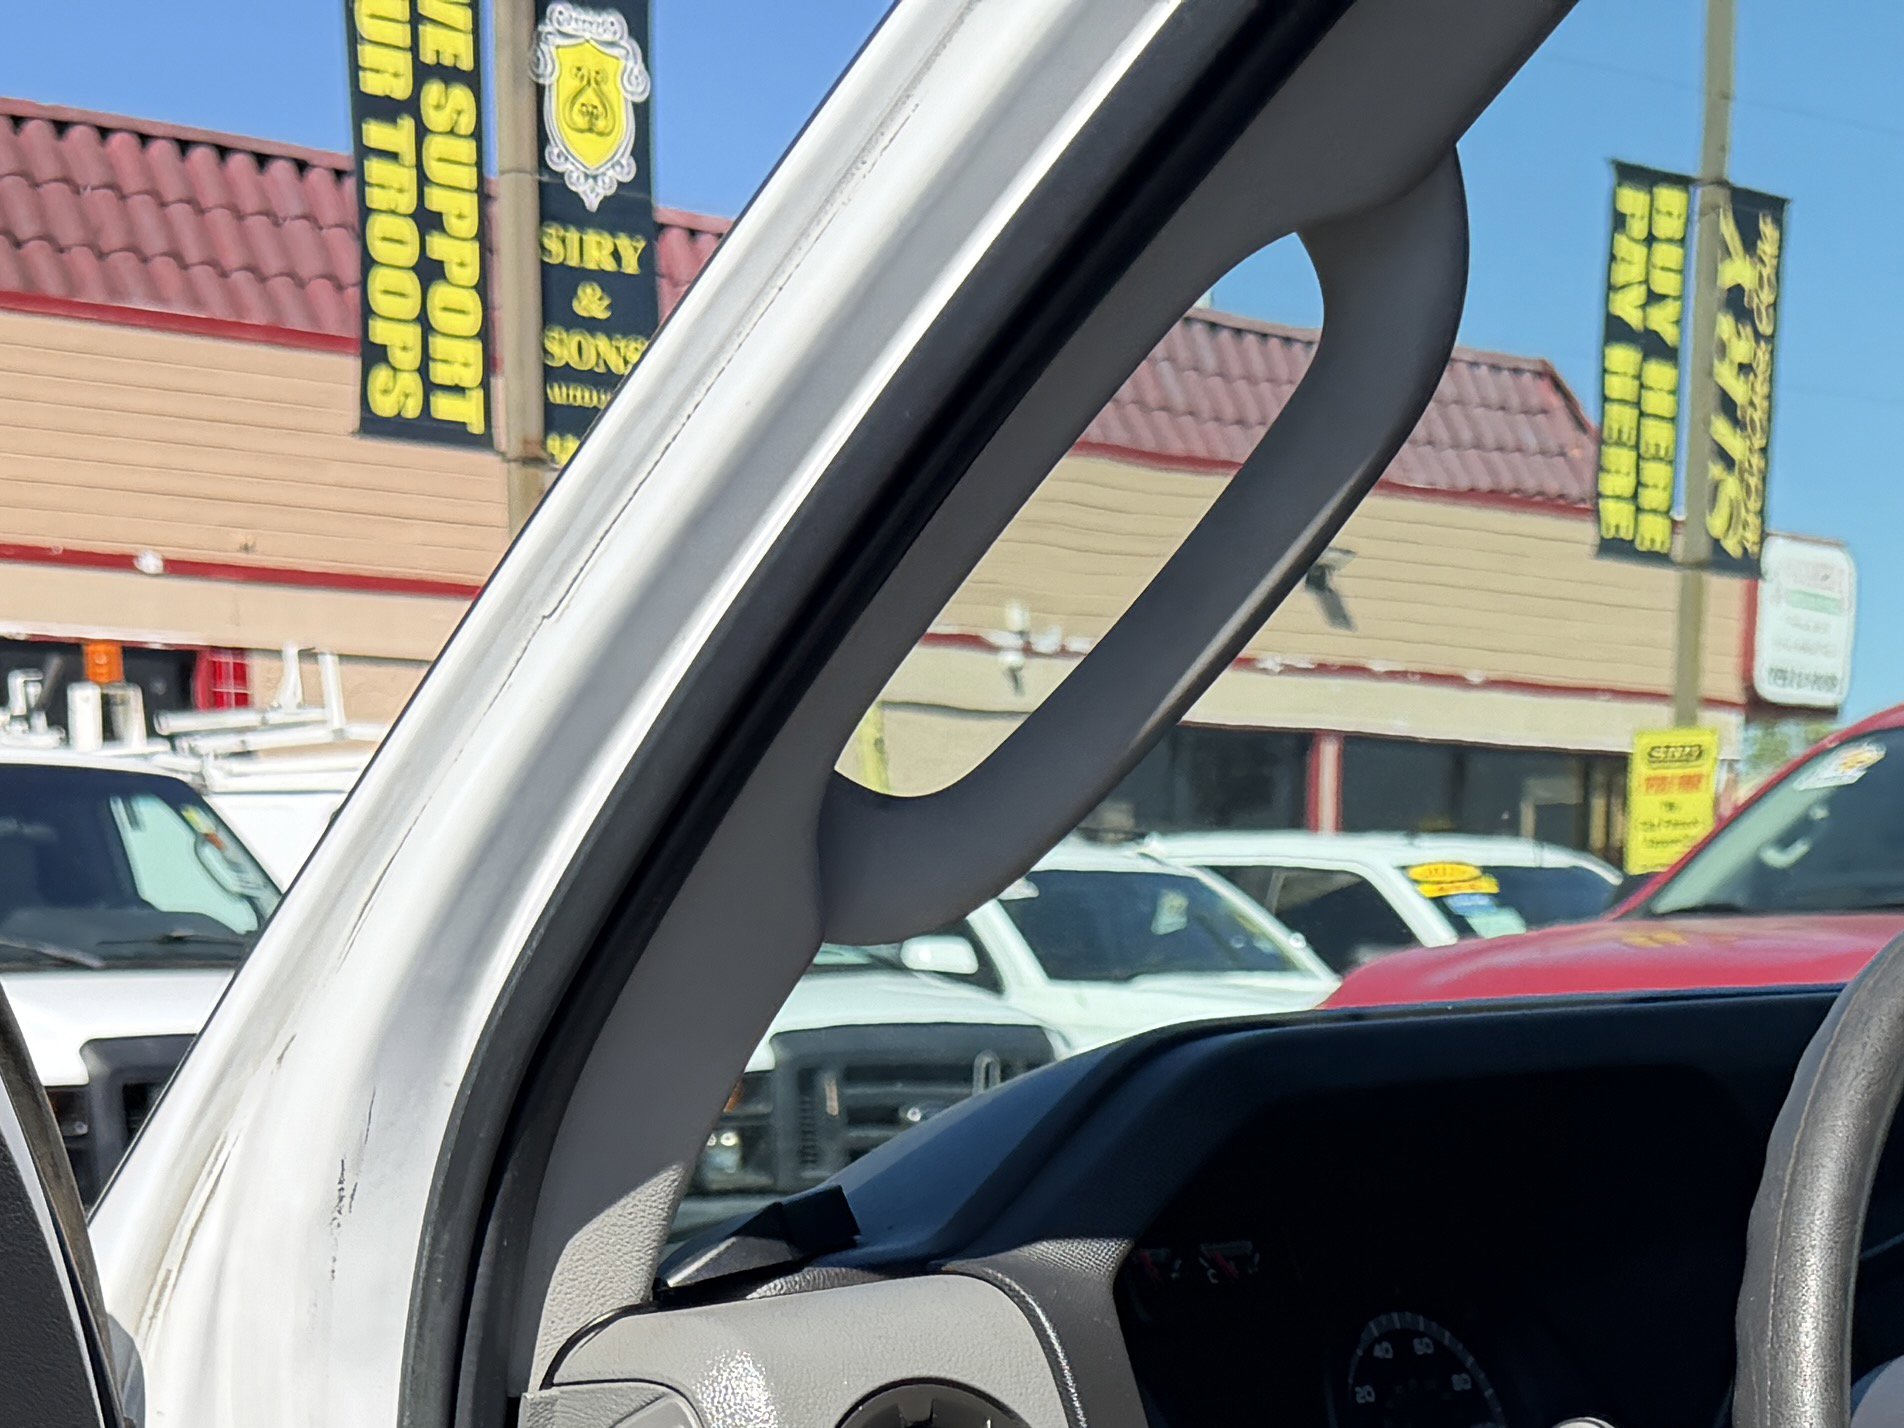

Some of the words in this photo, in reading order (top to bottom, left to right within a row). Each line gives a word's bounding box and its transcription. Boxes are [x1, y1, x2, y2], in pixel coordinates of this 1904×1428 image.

[360, 113, 424, 419] TROOPS
[419, 79, 485, 435] SUPPORT
[540, 221, 646, 275] SIRY
[572, 281, 611, 320] &
[1609, 184, 1651, 333] PAY
[543, 326, 649, 376] SONS
[1598, 344, 1643, 540] HERE
[1635, 359, 1679, 554] HERE
